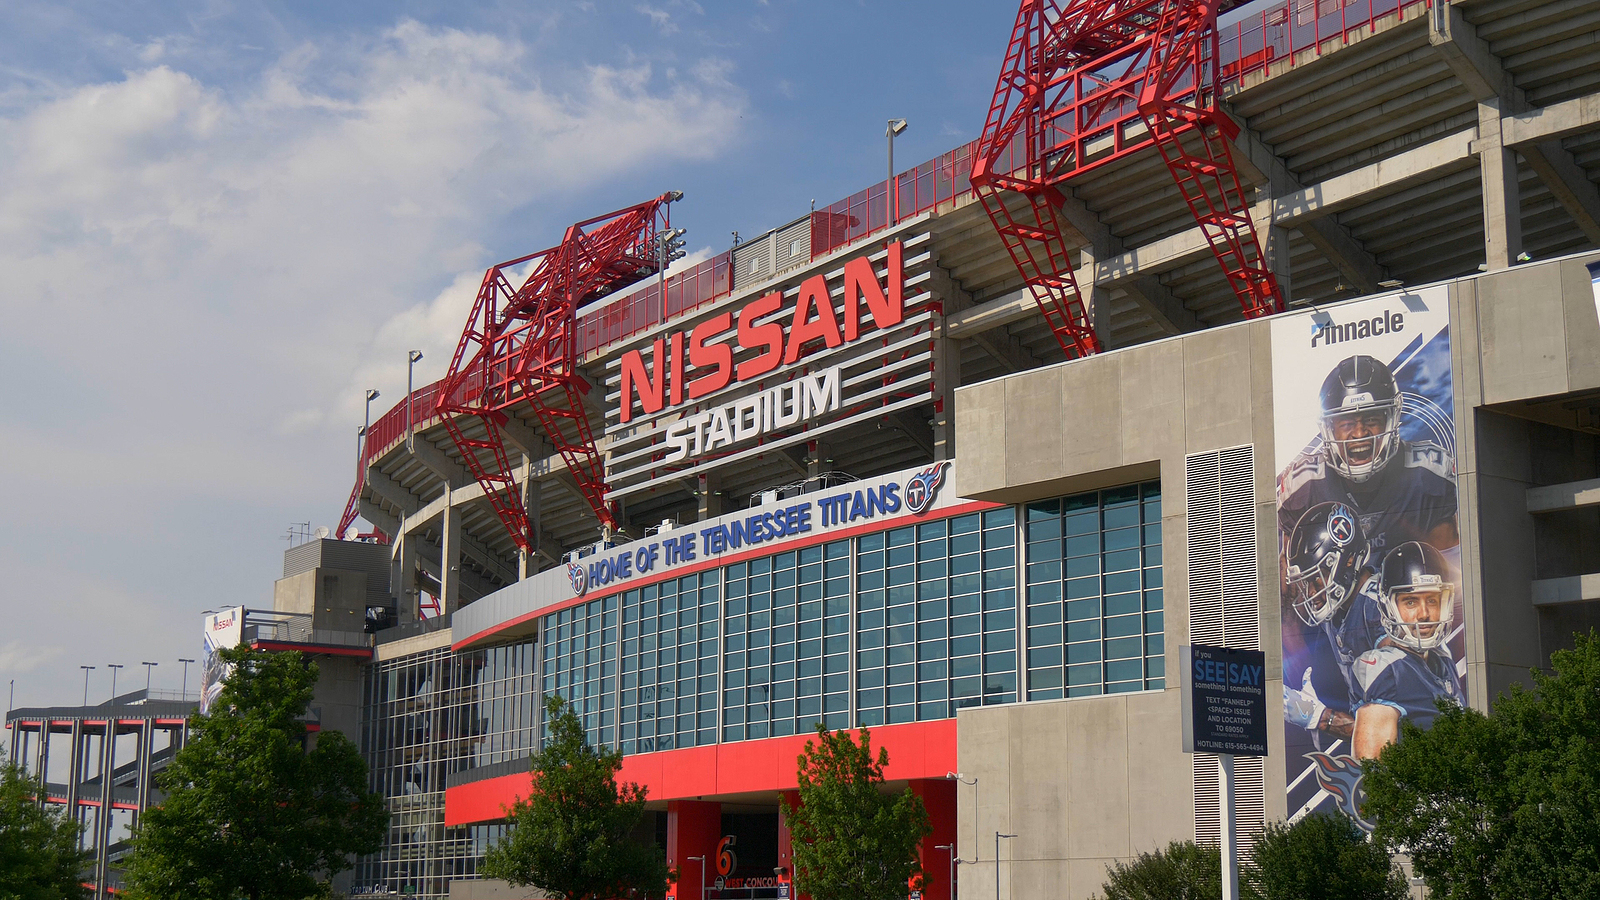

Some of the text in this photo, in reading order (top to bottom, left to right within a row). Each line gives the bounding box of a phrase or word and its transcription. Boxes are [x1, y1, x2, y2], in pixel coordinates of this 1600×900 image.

[620, 241, 904, 423] NISSAN
[1311, 310, 1404, 348] Pinnacle
[665, 367, 842, 464] STADIUM
[589, 482, 901, 588] HOME OF THE TENNESSEE TITANS
[213, 618, 233, 631] NISSAN
[1195, 660, 1261, 686] SEE SAY
[1195, 682, 1261, 695] something something
[1206, 696, 1220, 704] TEXT
[1234, 708, 1251, 716] ISSUE
[1222, 716, 1252, 725] LOCATION
[1225, 725, 1244, 733] 69050
[1197, 740, 1224, 749] HOTLINE:
[716, 835, 737, 877] 6
[725, 878, 744, 888] WEST
